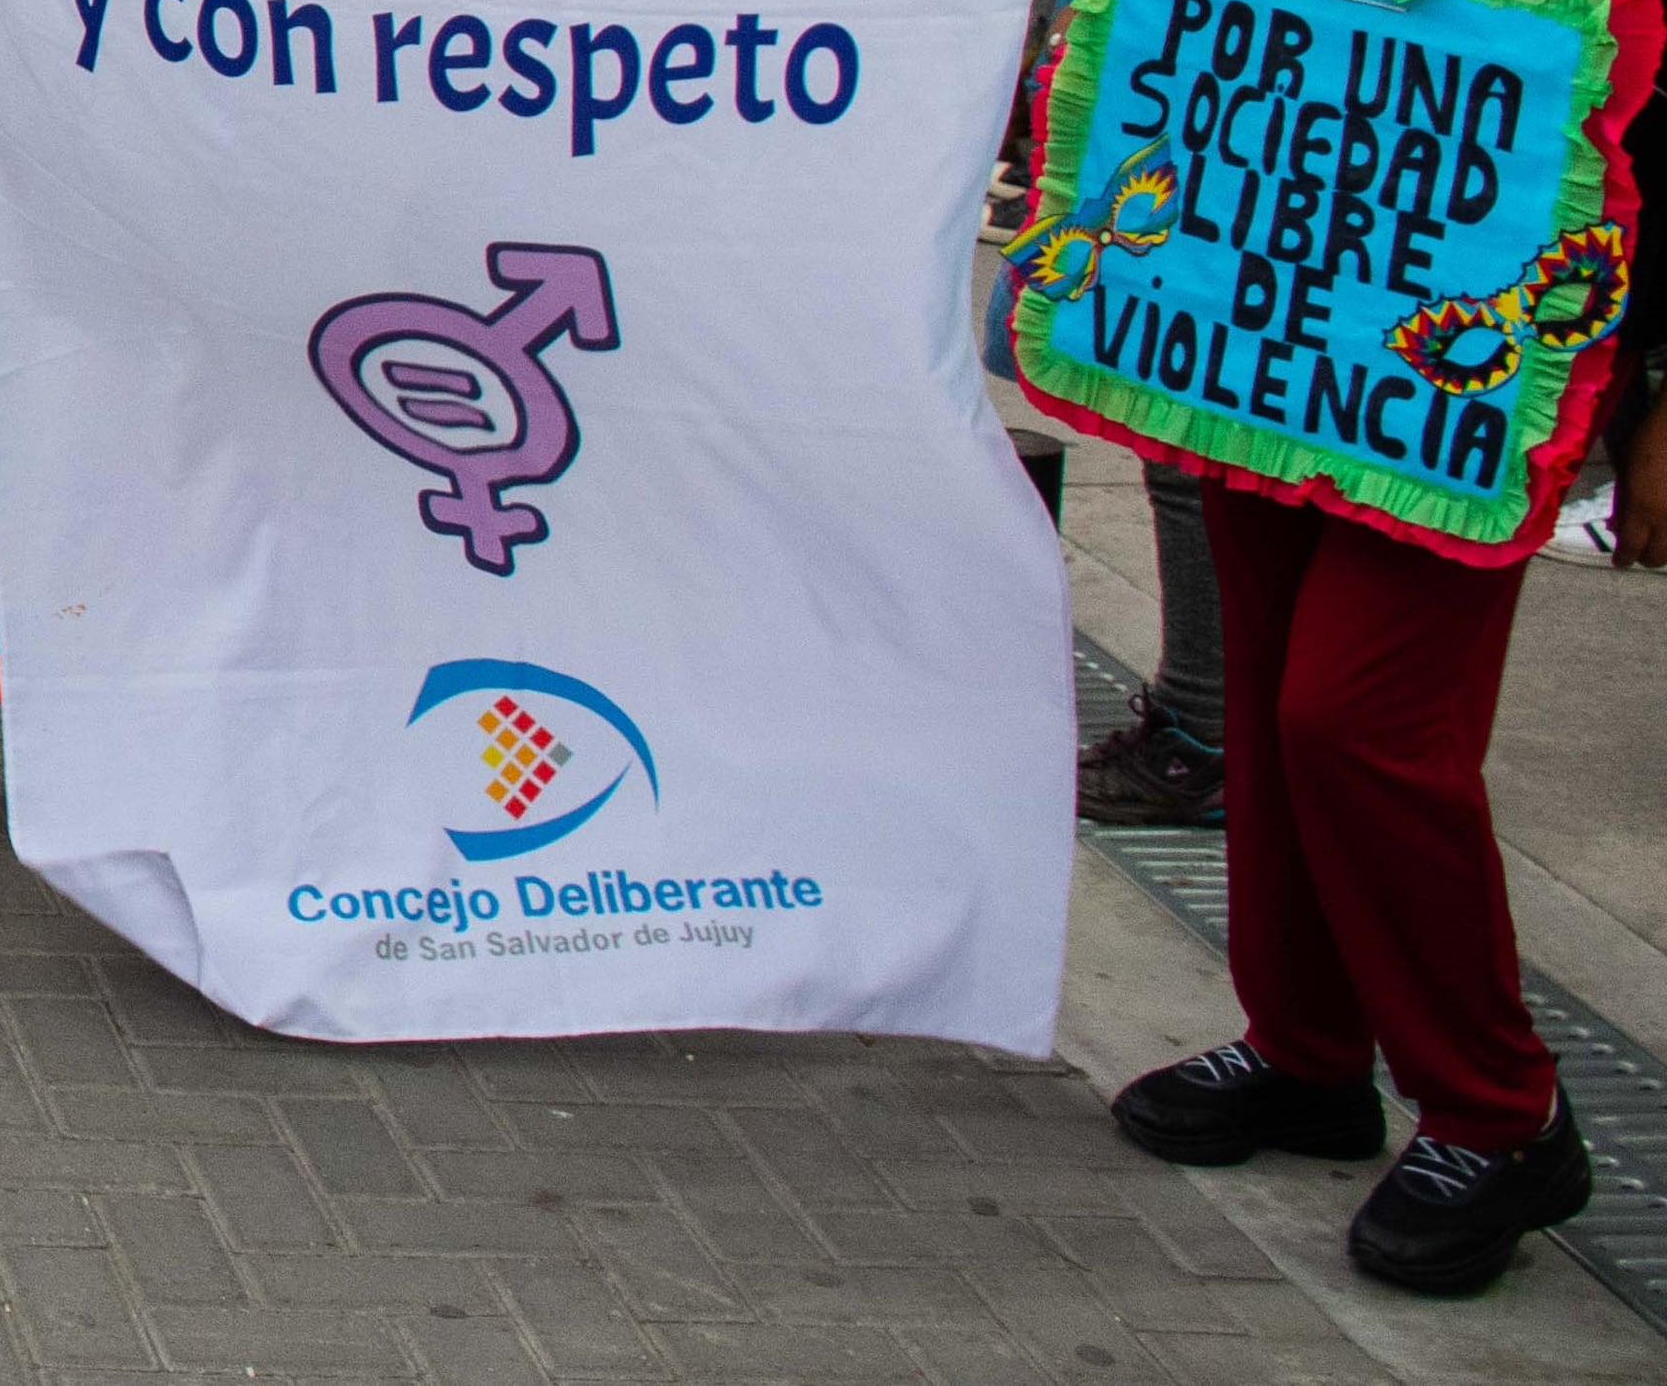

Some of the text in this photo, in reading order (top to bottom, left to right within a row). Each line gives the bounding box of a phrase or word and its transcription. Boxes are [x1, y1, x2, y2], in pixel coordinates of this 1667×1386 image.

[372, 11, 861, 159] respeto
[1344, 30, 1524, 151] UNA
[1179, 154, 1447, 299] LIBRE
[1230, 250, 1336, 352] DE
[286, 870, 824, 934] Concejo Deliberante
[375, 920, 755, 962] de San Salvador de Jujuy
